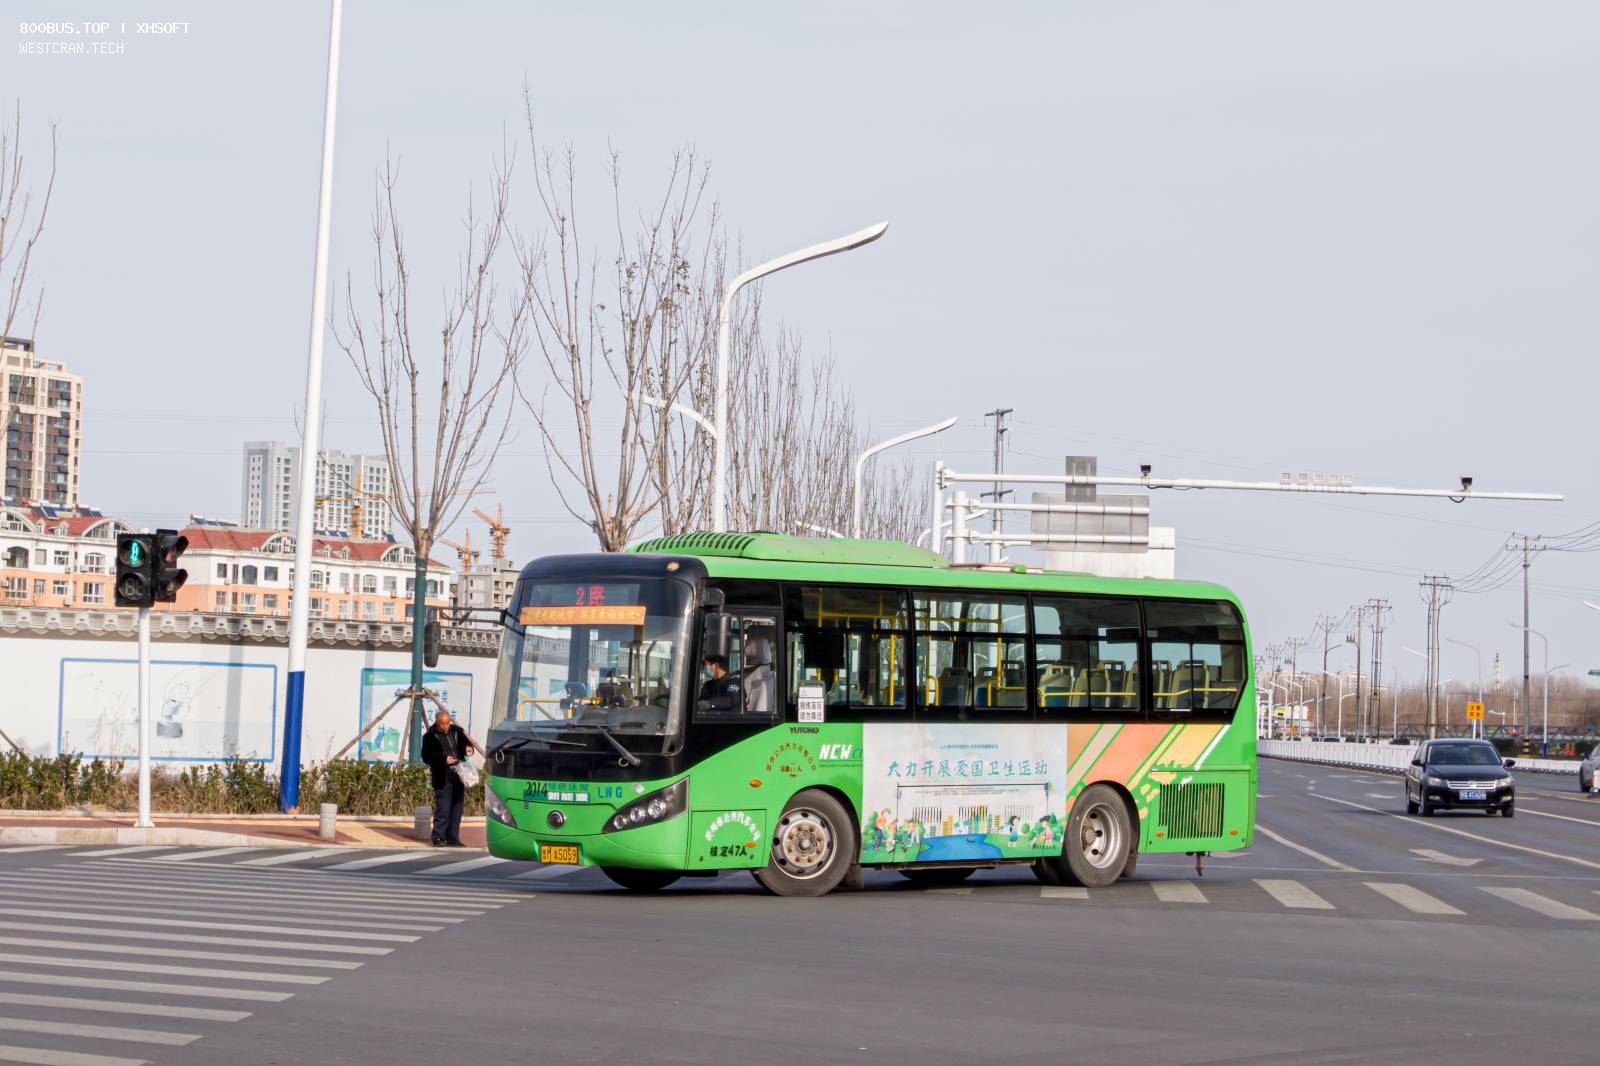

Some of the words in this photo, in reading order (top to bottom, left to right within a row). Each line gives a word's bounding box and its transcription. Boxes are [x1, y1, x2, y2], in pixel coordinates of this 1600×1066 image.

[818, 744, 852, 760] NEW
[886, 760, 1049, 778] 大力开展爱国卫生运动
[525, 782, 548, 797] 2014
[597, 786, 623, 799] LNG
